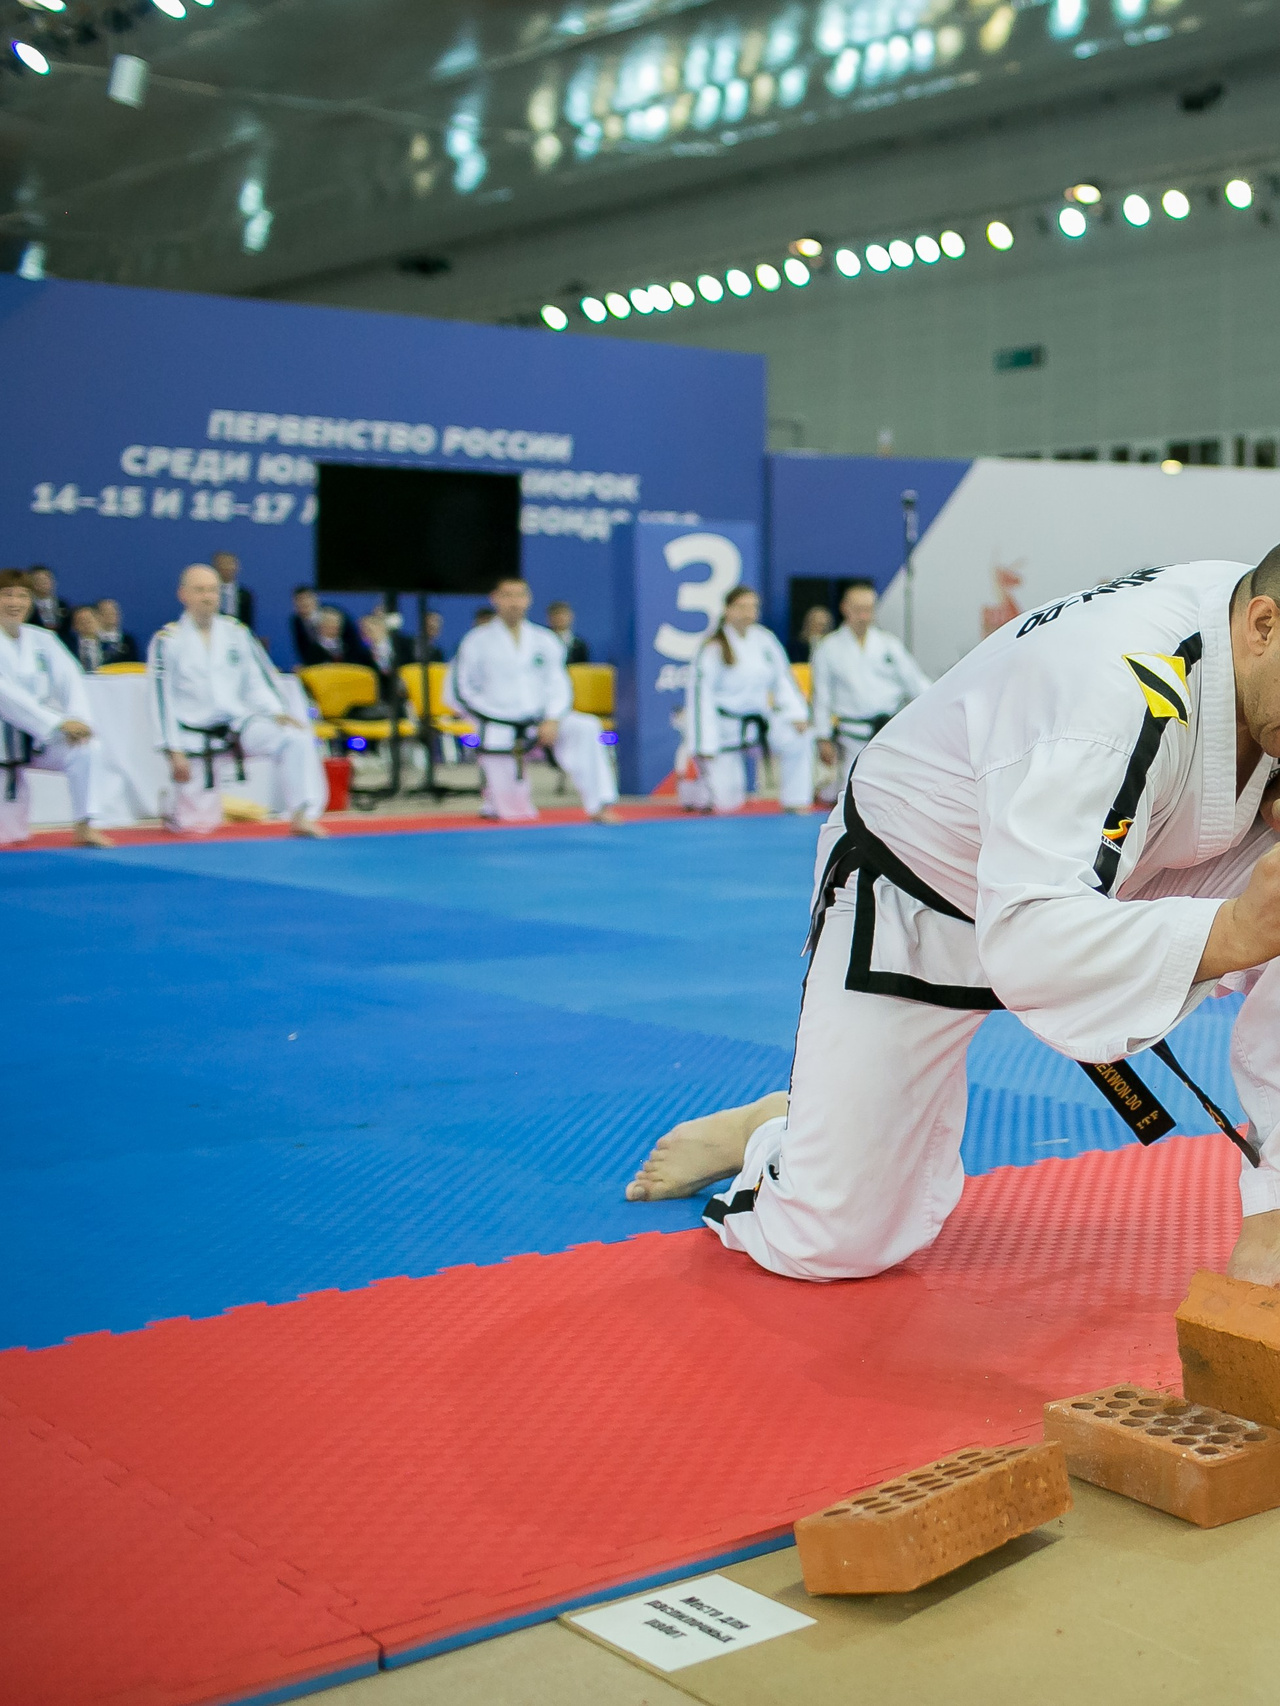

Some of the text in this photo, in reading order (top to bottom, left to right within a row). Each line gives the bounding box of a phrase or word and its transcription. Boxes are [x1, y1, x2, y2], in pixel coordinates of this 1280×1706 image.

[207, 409, 574, 464] ПЕРВЕНСТВО РОССИИ
[120, 444, 250, 486] СРЕДИ
[519, 468, 641, 503] ИОРОК
[151, 487, 184, 520] И
[653, 531, 744, 664] 3
[1094, 1063, 1143, 1111] EKWON-DO
[1136, 1110, 1159, 1130] ITF
